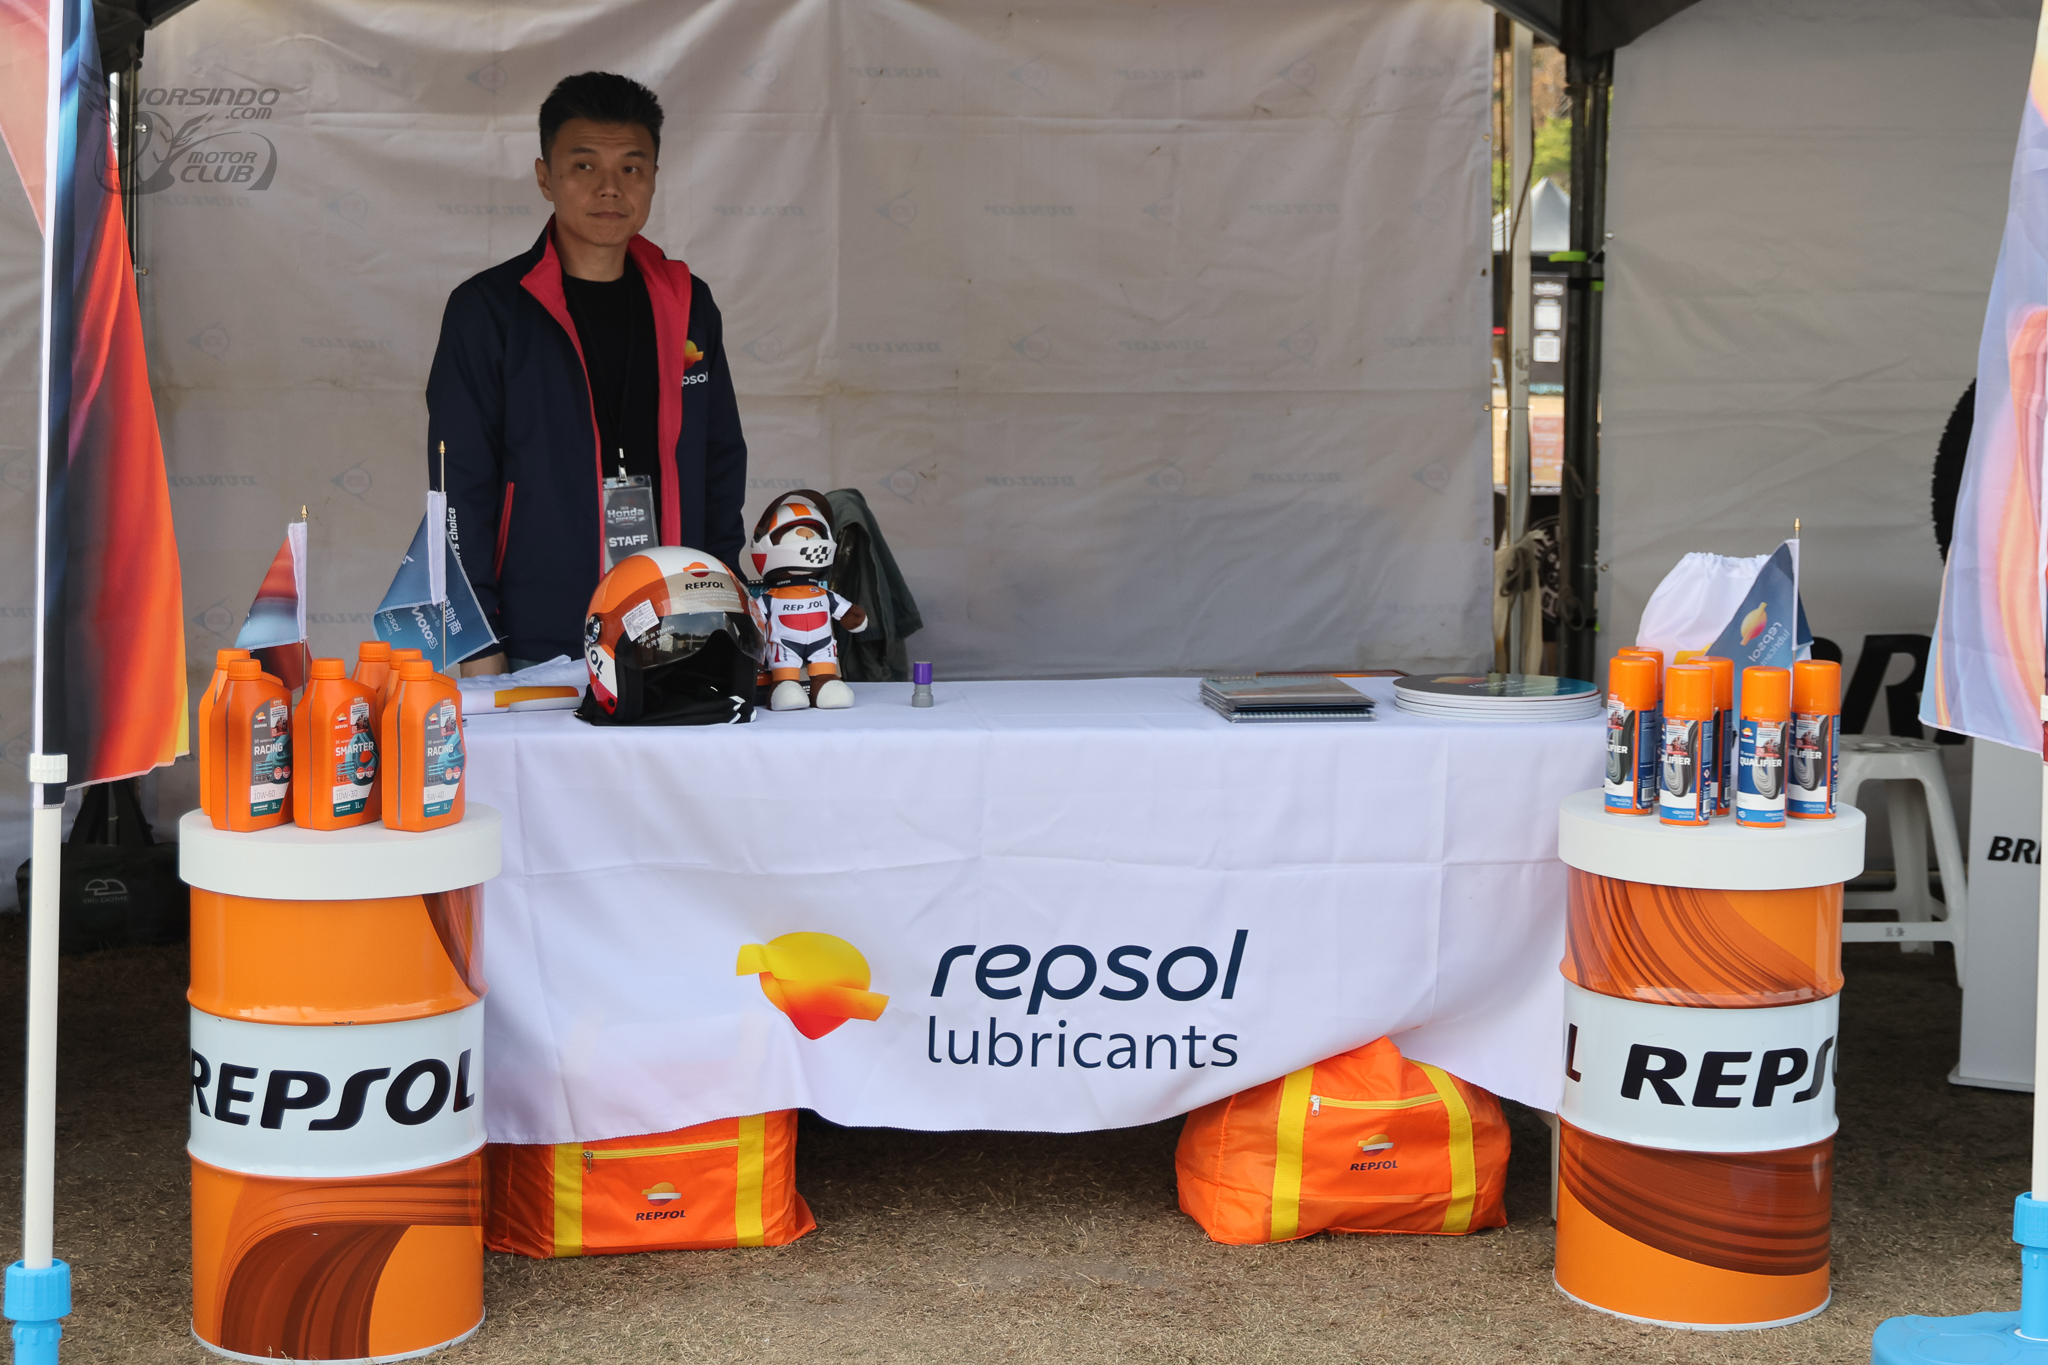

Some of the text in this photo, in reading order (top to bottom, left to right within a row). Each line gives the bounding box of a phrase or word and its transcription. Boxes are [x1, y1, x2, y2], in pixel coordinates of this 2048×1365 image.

[682, 371, 709, 388] psol
[607, 507, 645, 518] Honda
[447, 507, 459, 540] choice
[609, 534, 648, 548] STAFF
[685, 581, 725, 590] REPSOL
[254, 742, 284, 756] RACING
[335, 741, 375, 757] SMARTER
[427, 743, 454, 757] RACING
[1740, 755, 1783, 768] QUALIFIER
[336, 789, 358, 801] 10W-30
[930, 929, 1249, 1015] repsol
[928, 1016, 1238, 1070] lubricants
[1620, 1034, 1838, 1109] REPS
[191, 1048, 475, 1131] REPSOL
[1350, 1160, 1398, 1171] REPSOL
[635, 1210, 686, 1221] REPSOL
